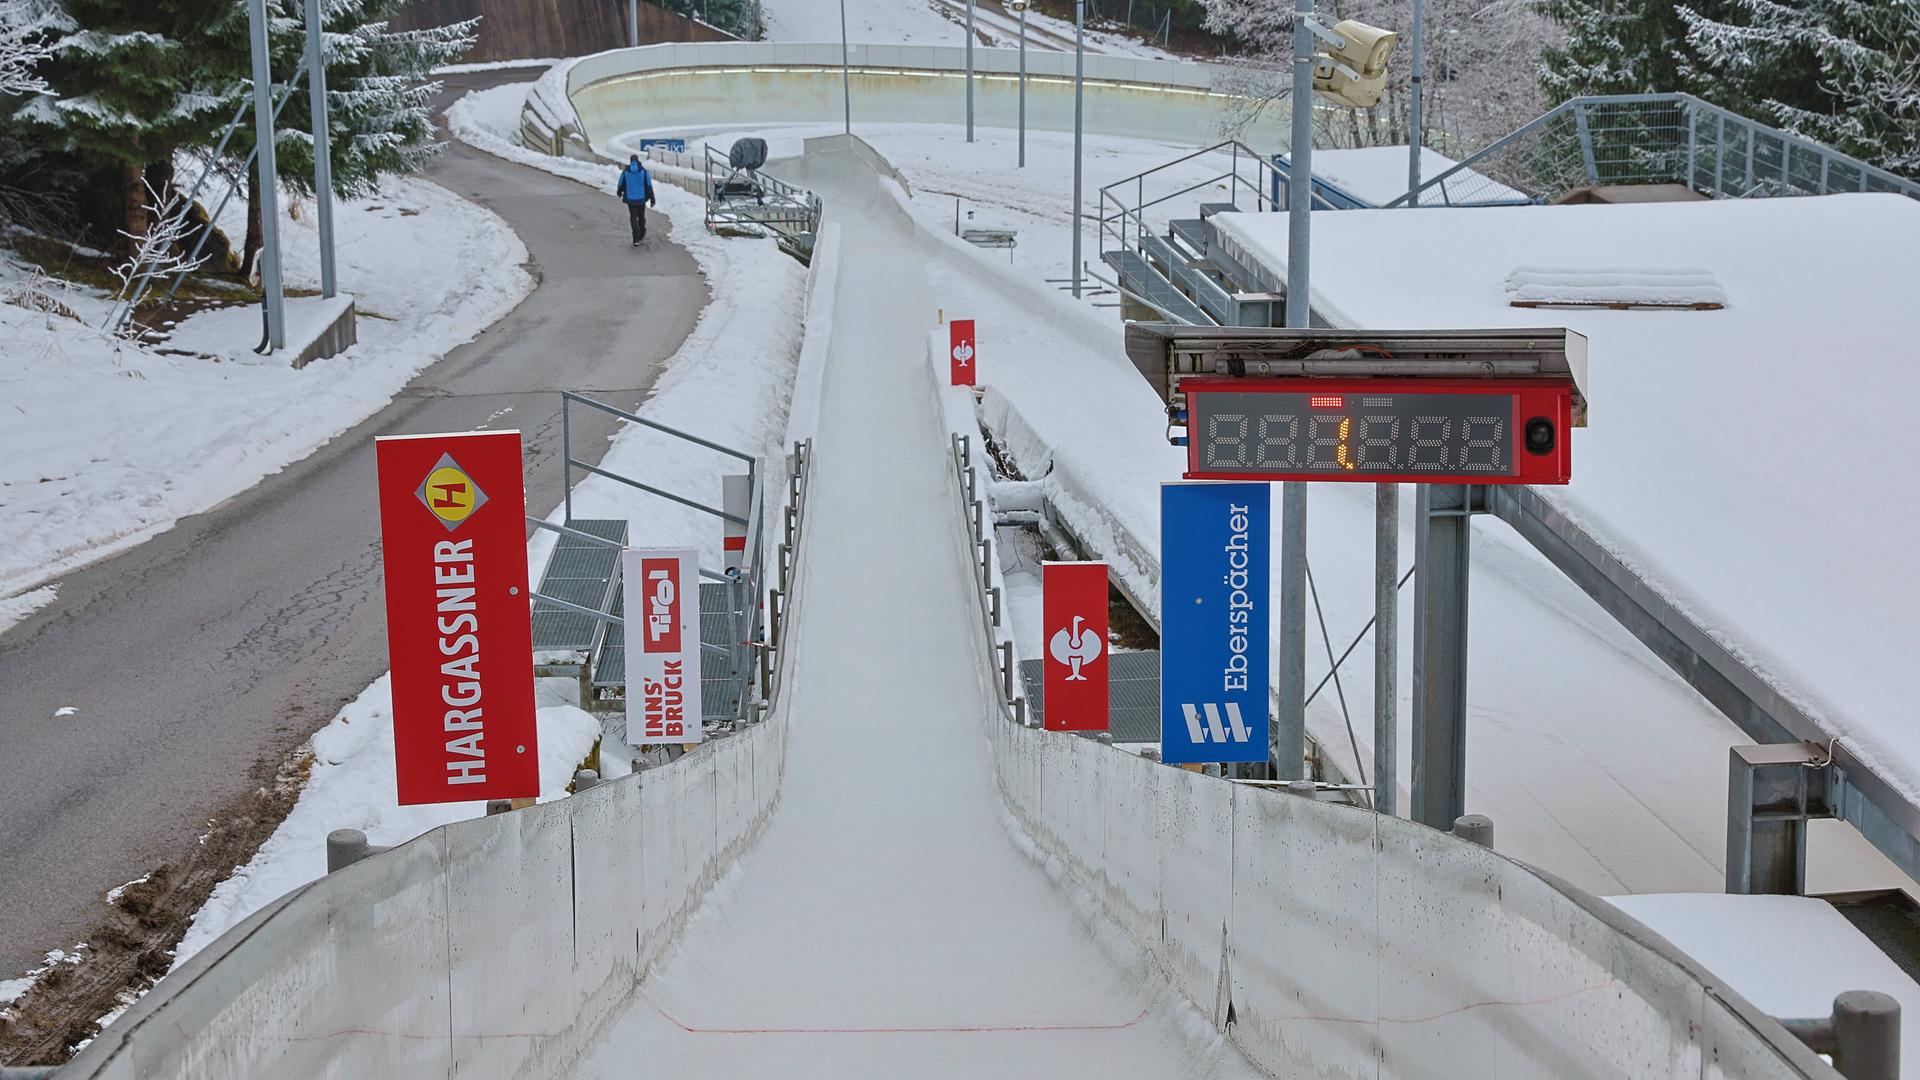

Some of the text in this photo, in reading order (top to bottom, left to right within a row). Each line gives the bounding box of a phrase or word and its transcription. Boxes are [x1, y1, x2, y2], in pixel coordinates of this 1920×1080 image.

[434, 538, 487, 785] HARGASSNER
[648, 569, 675, 642] Tirol
[1224, 503, 1253, 692] Eberspächer
[664, 660, 684, 737] BRUCK
